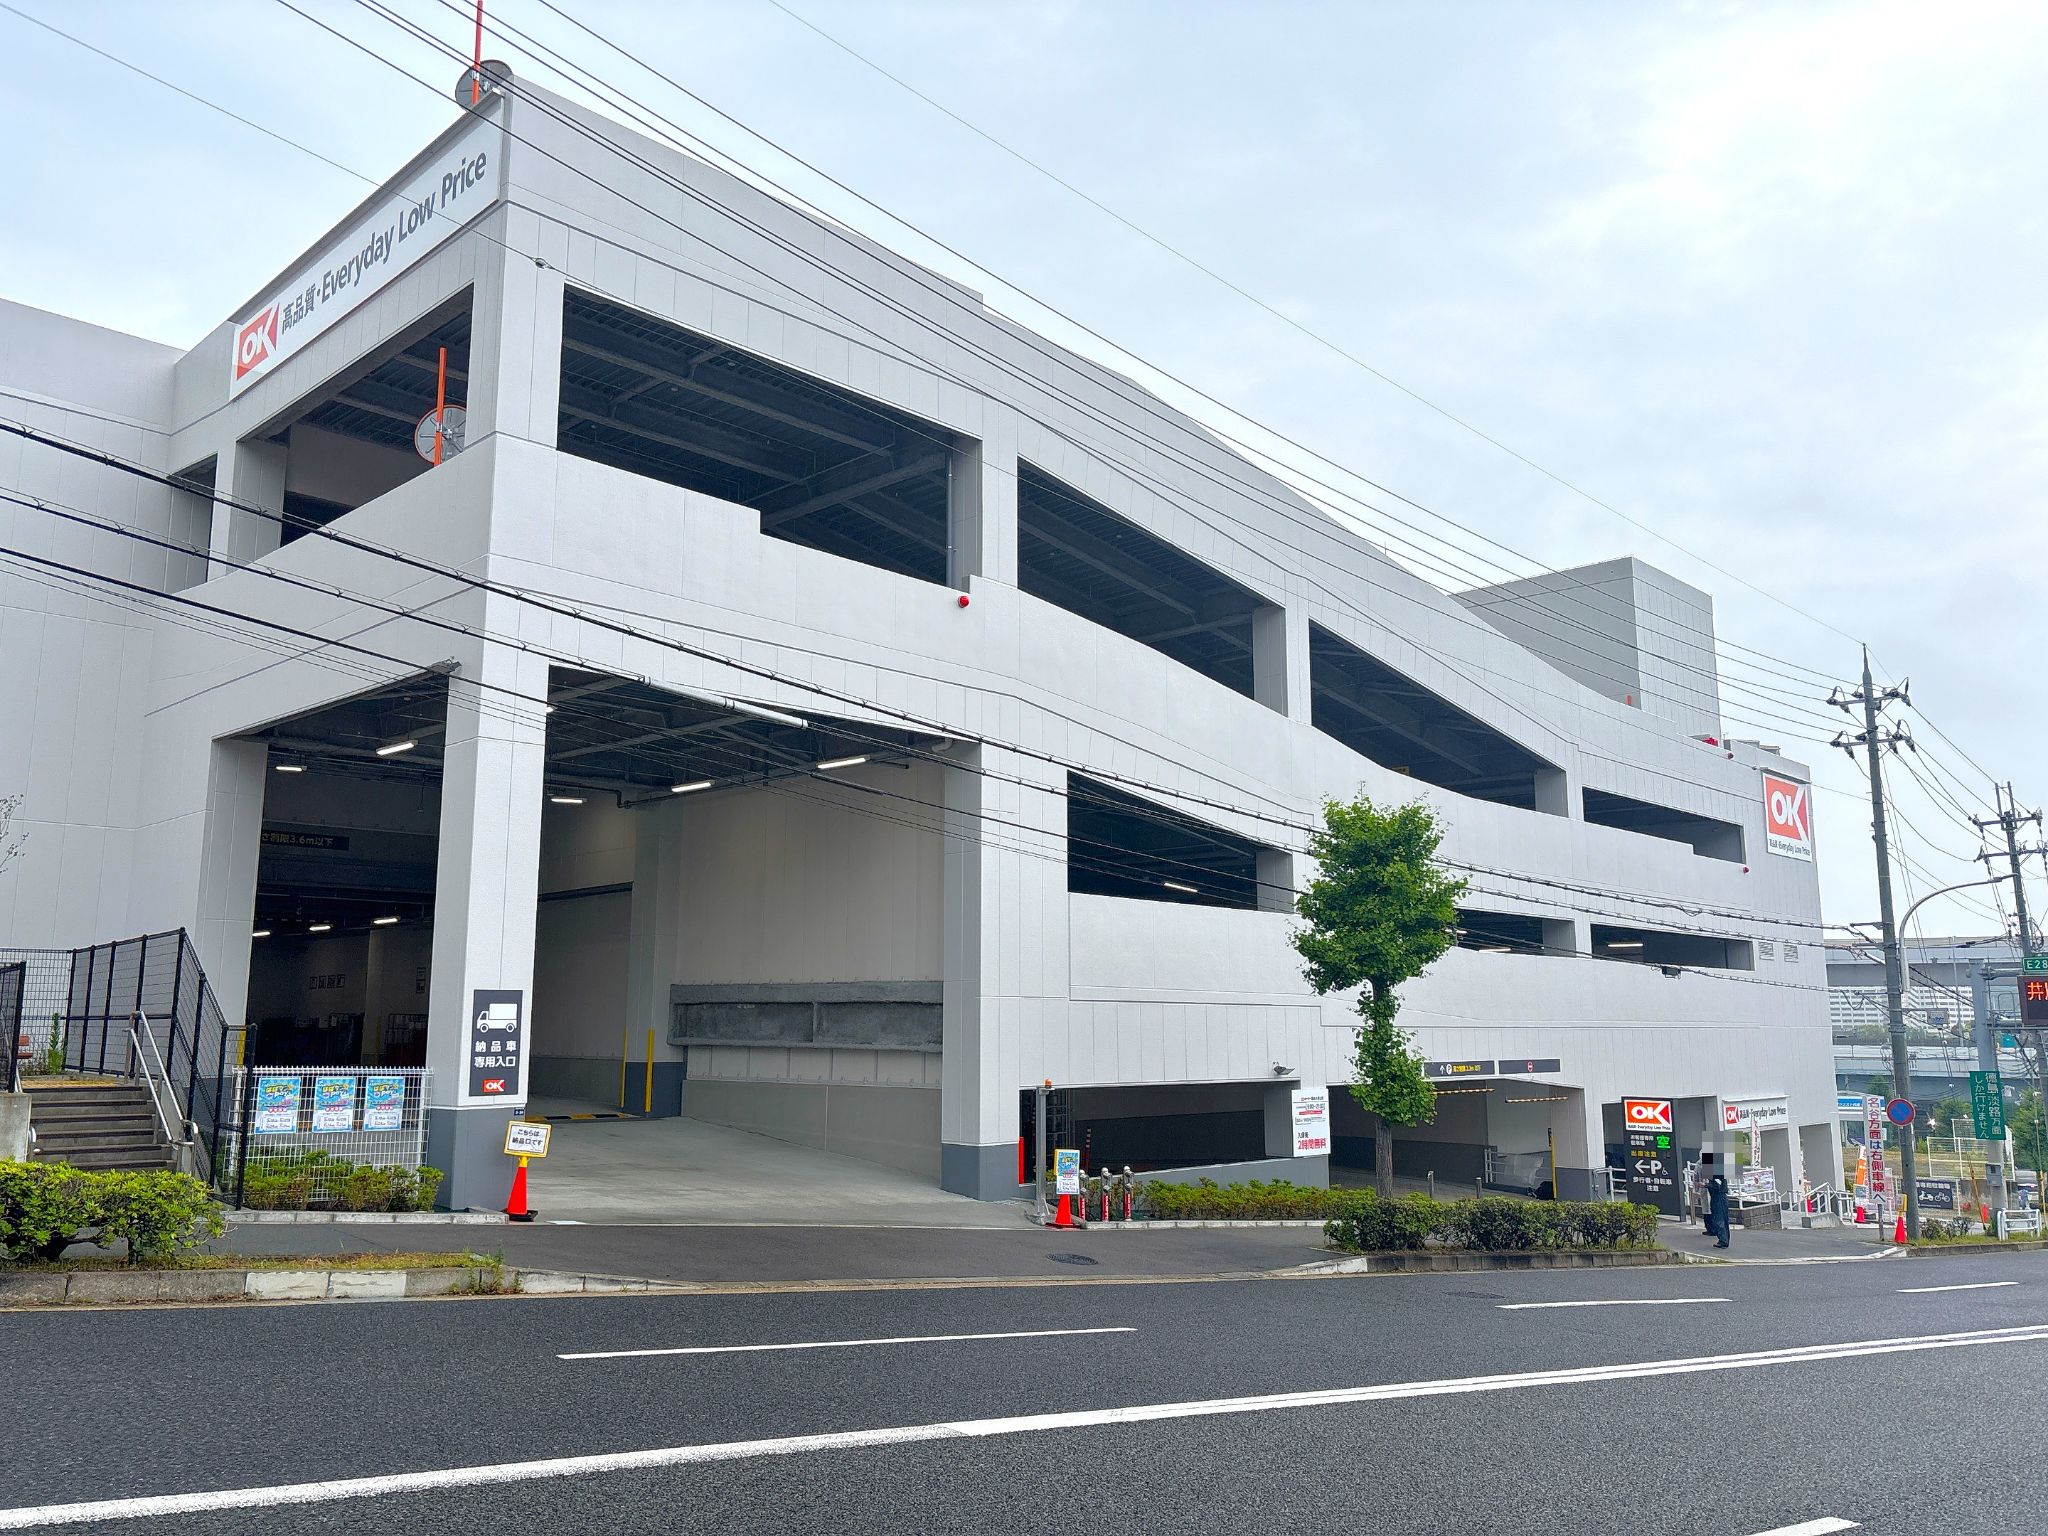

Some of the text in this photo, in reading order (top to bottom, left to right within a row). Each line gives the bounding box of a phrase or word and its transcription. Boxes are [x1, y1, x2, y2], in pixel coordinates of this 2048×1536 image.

[399, 191, 436, 243] Low
[441, 152, 487, 209] Price
[241, 303, 279, 364] OK
[1771, 784, 1809, 841] OK
[2026, 960, 2048, 969] E28
[475, 1040, 517, 1053] 納品車
[474, 1056, 516, 1068] 専用入口
[485, 1079, 505, 1092] OK
[1631, 1101, 1669, 1125] OK
[1974, 1077, 1989, 1139] しか行けません
[518, 1128, 540, 1137] こちらは
[1656, 1134, 1671, 1149] 空
[1868, 1097, 1886, 1203] 名谷方面は右側車線へ
[1650, 1160, 1662, 1175] P
